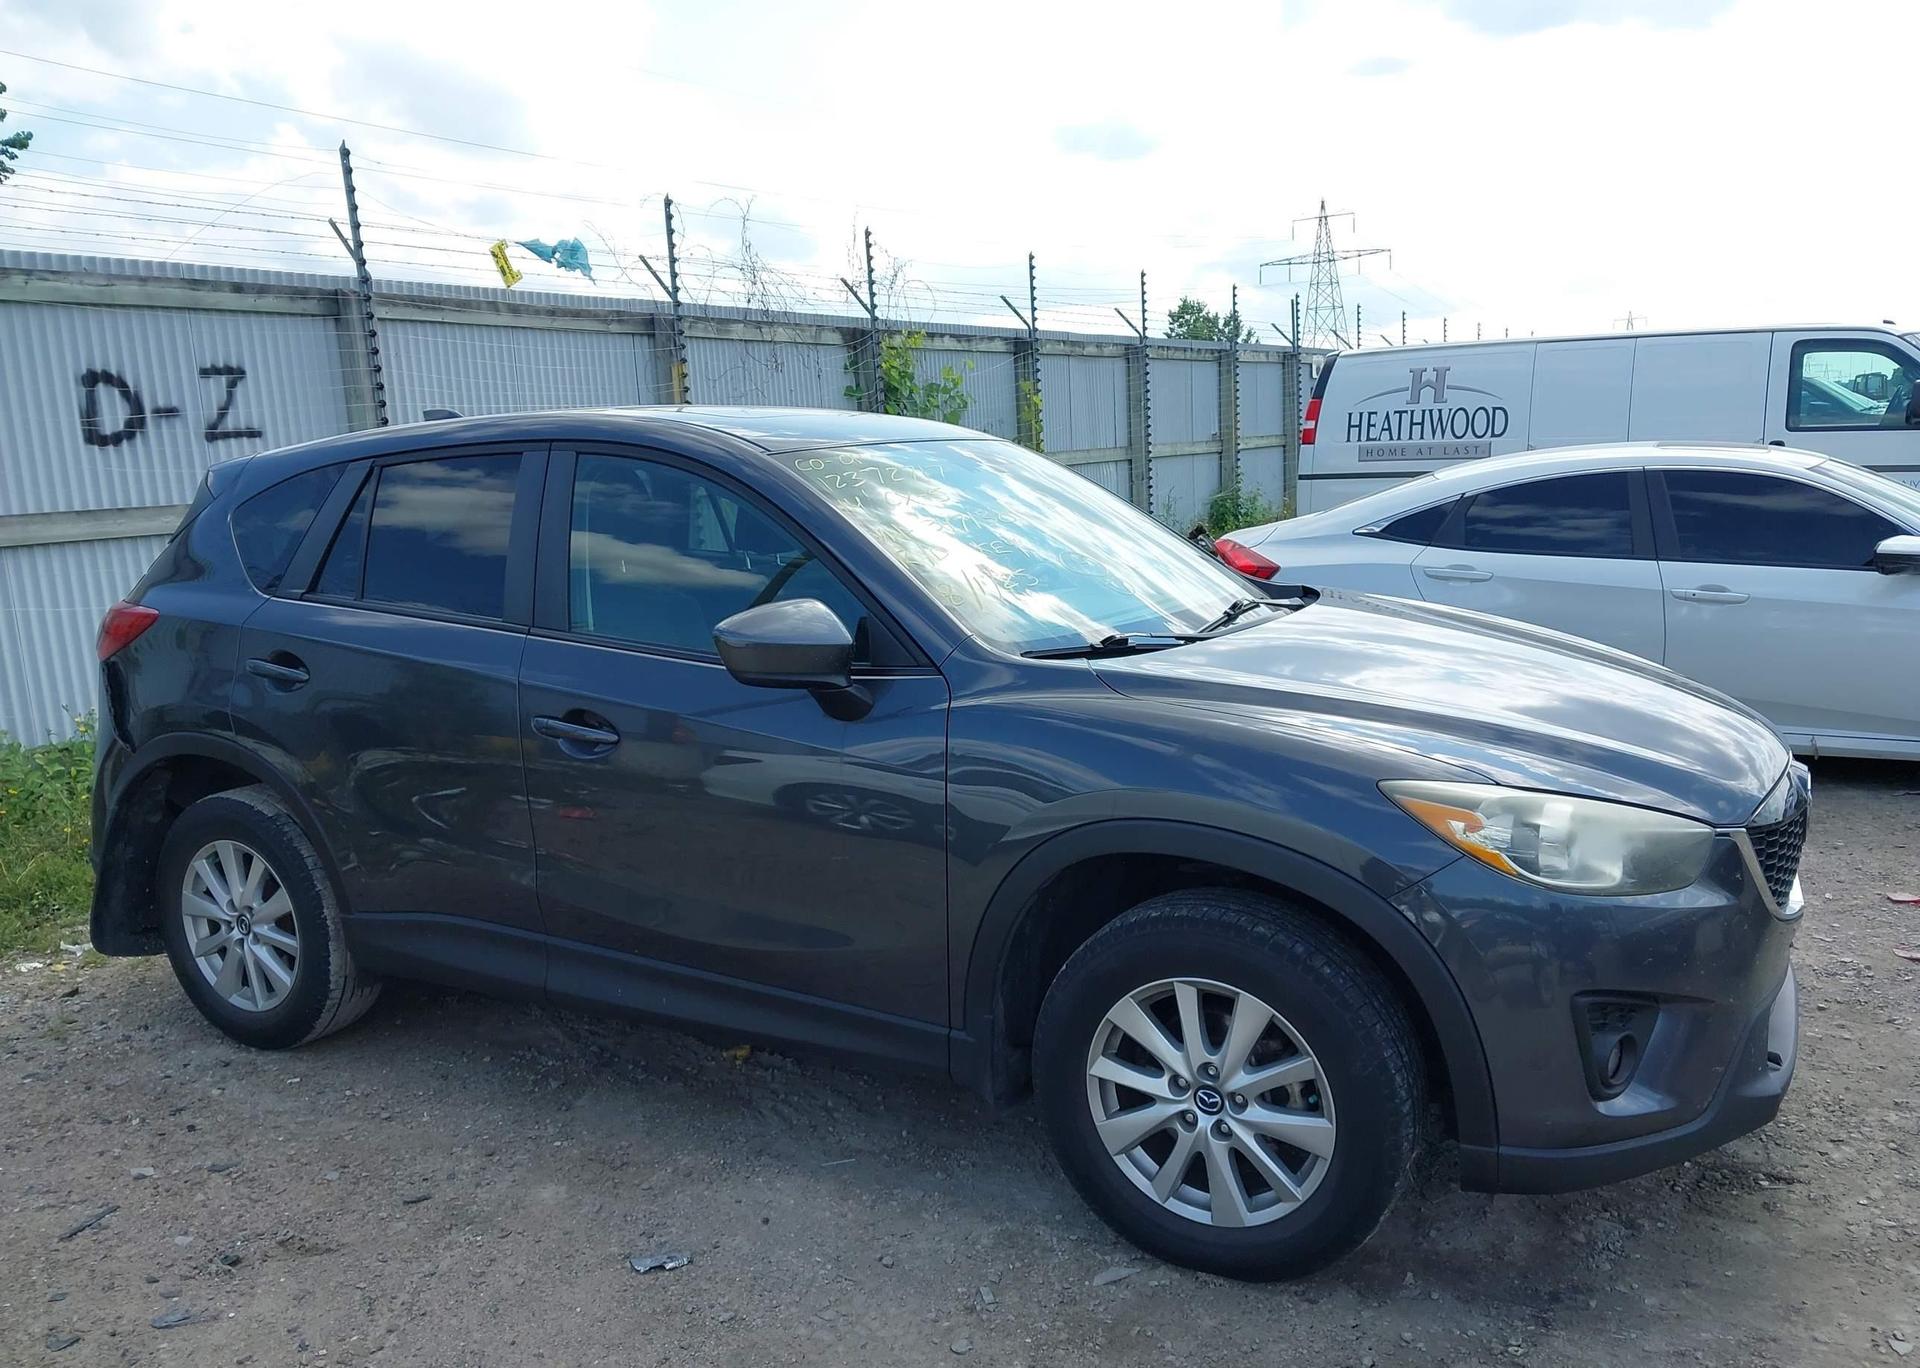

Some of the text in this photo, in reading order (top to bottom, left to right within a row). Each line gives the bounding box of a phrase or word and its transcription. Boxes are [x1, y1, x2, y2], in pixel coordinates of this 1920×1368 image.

[80, 366, 263, 447] D-Z
[1345, 406, 1509, 443] HEATHWOOD
[1366, 447, 1407, 457] HOME
[1416, 446, 1434, 456] AT
